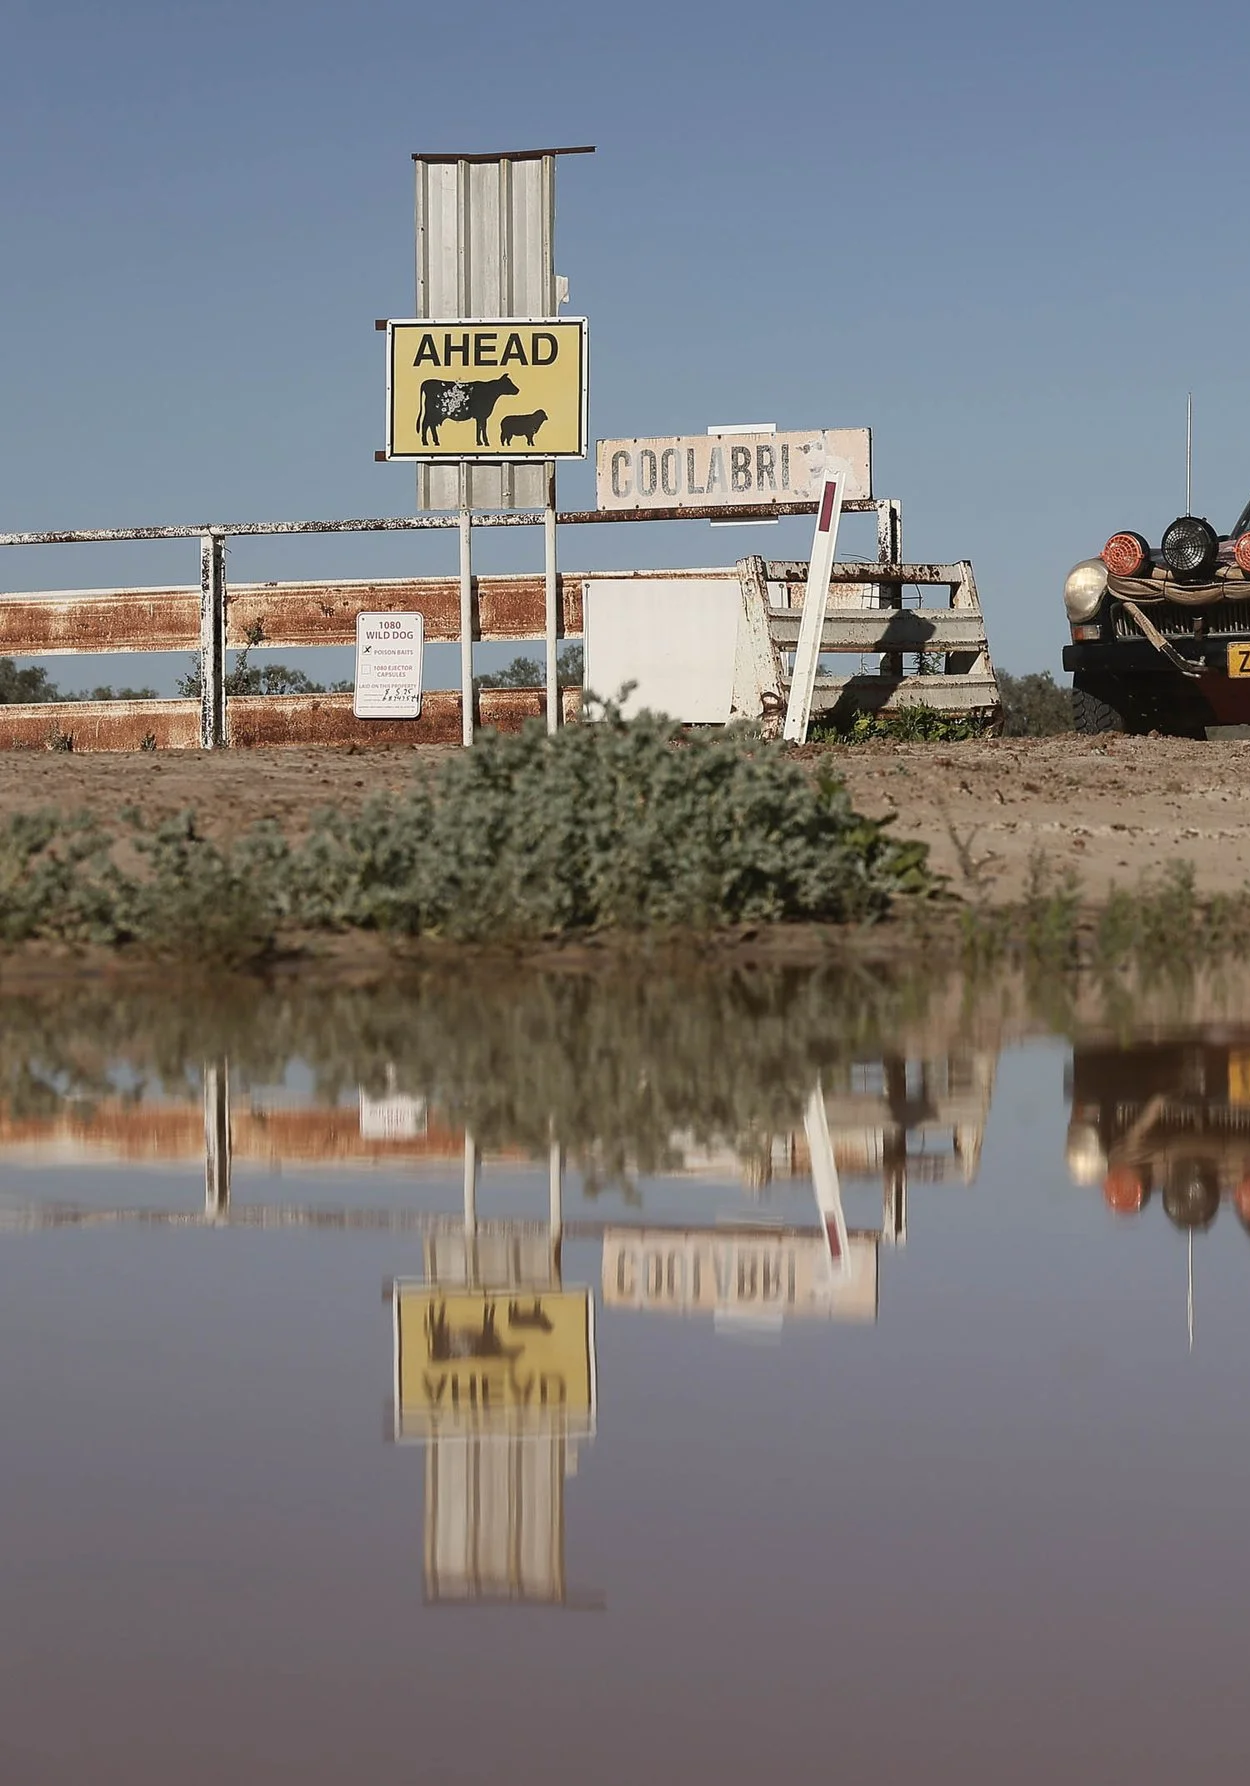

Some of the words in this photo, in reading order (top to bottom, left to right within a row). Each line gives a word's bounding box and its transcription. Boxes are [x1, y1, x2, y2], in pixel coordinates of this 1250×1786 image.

[413, 333, 558, 367] AHEAD
[611, 444, 790, 498] COOLABRI
[366, 631, 390, 639] WILD
[393, 631, 414, 639] DOG
[379, 621, 401, 629] 1080
